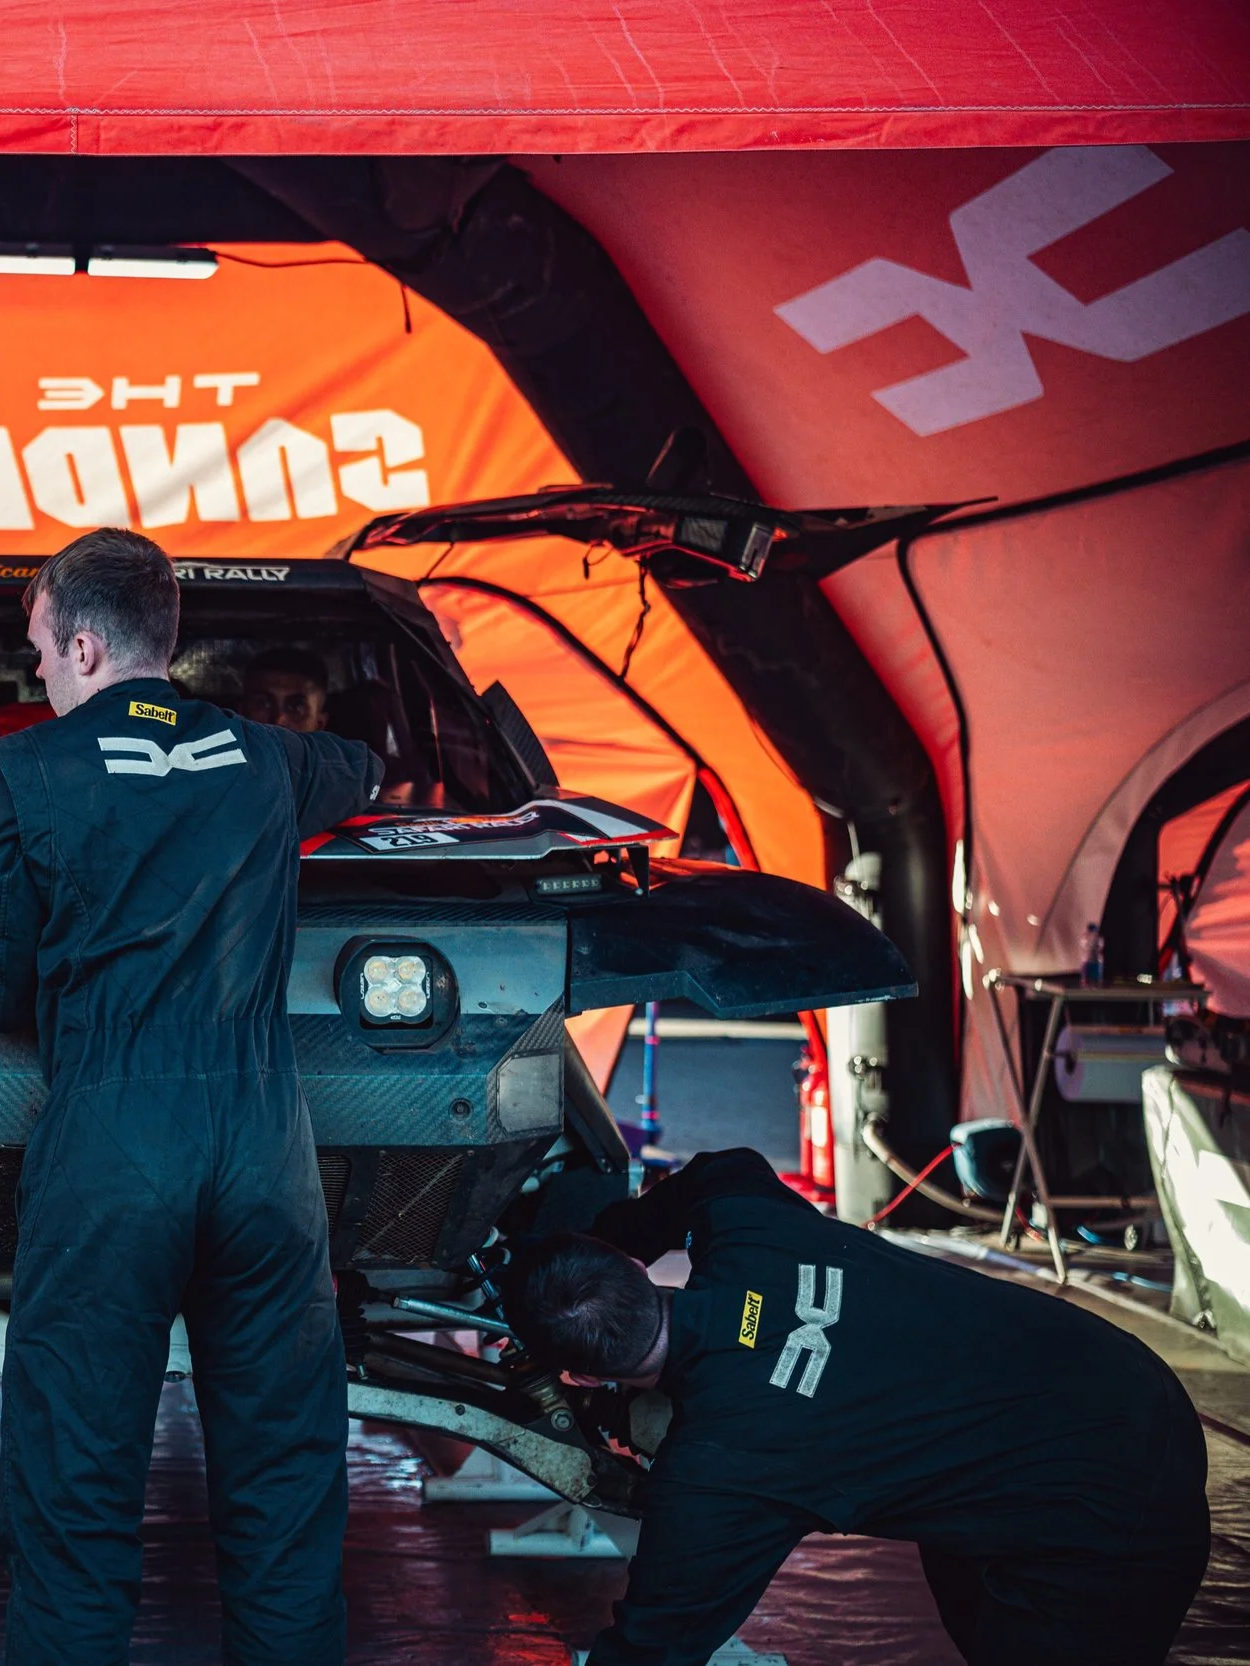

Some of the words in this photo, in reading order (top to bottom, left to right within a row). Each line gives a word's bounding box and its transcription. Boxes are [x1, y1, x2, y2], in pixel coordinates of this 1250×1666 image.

[203, 566, 290, 581] RALLY
[135, 703, 174, 723] Sabelt
[380, 833, 439, 848] 219
[741, 1295, 761, 1341] Sabelt
